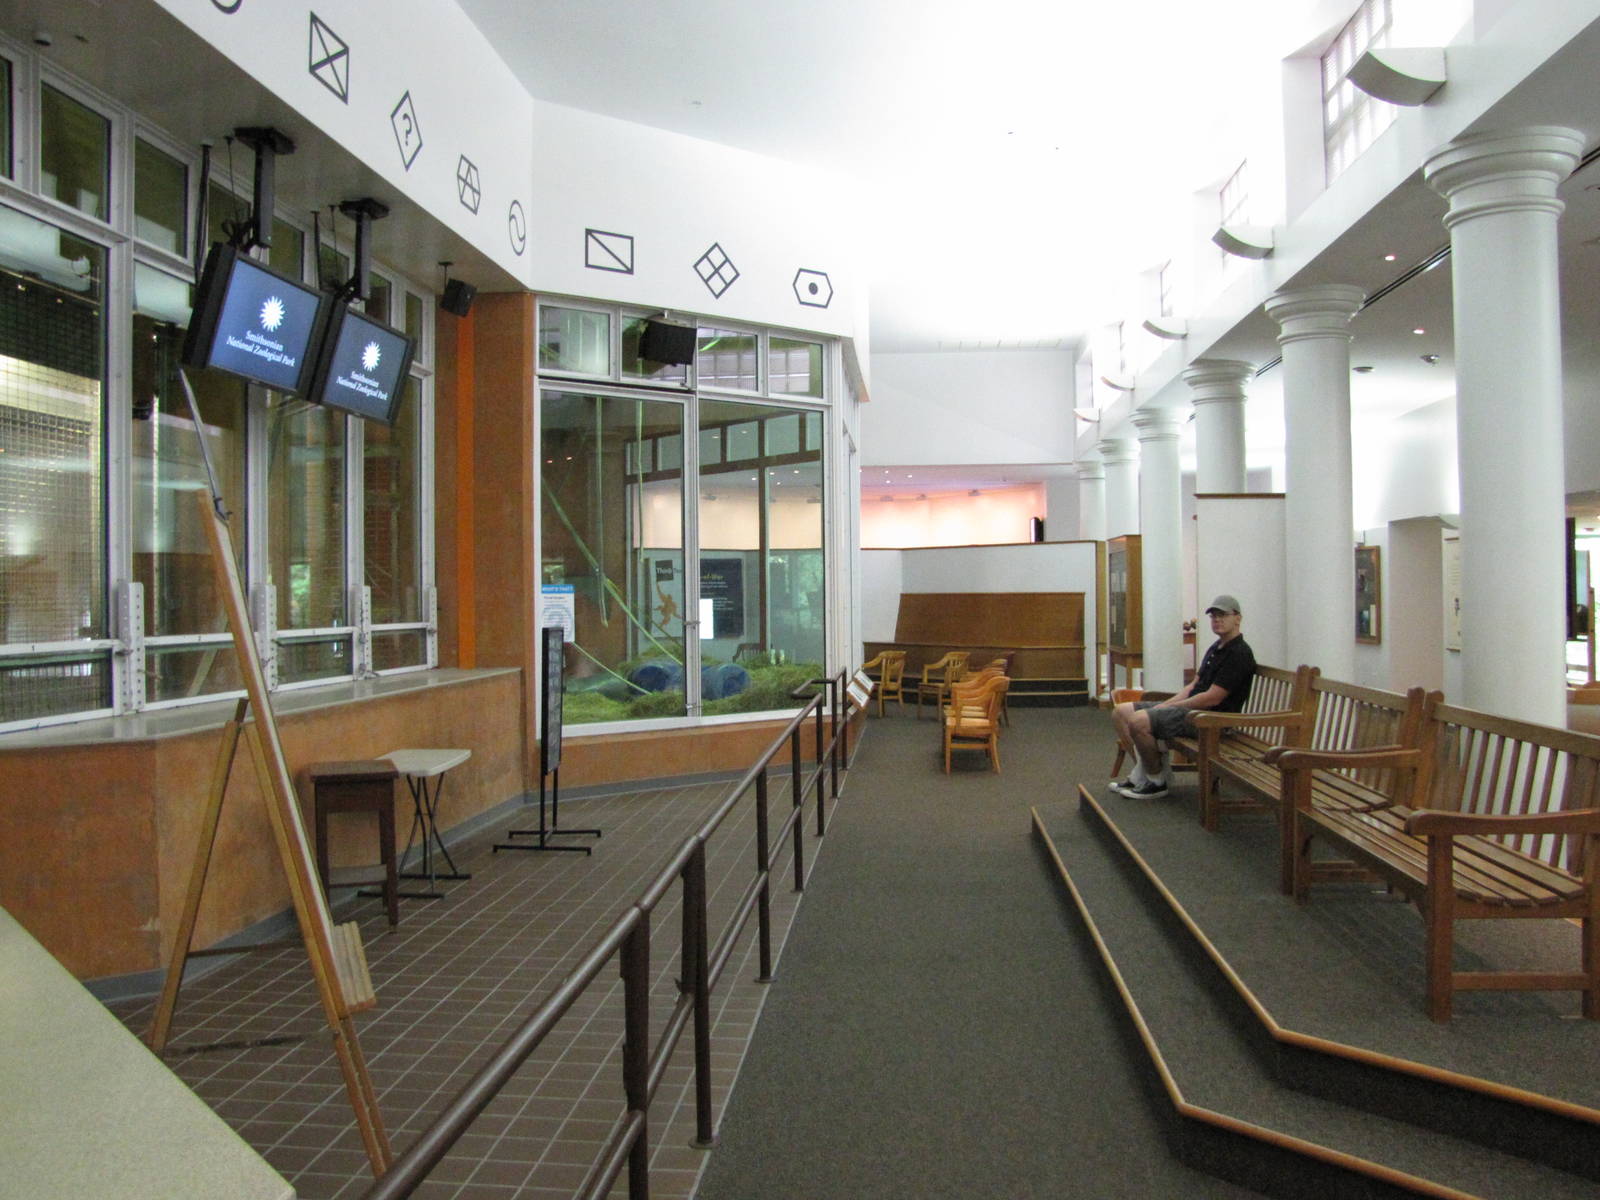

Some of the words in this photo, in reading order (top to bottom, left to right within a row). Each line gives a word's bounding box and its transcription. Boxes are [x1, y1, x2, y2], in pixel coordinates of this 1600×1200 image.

[226, 335, 254, 352] National
[253, 345, 283, 362] Zoological
[282, 354, 296, 367] Park
[245, 330, 284, 352] Smithsonian
[336, 376, 357, 389] National
[377, 390, 388, 400] Park
[350, 371, 380, 388] Smithsonian
